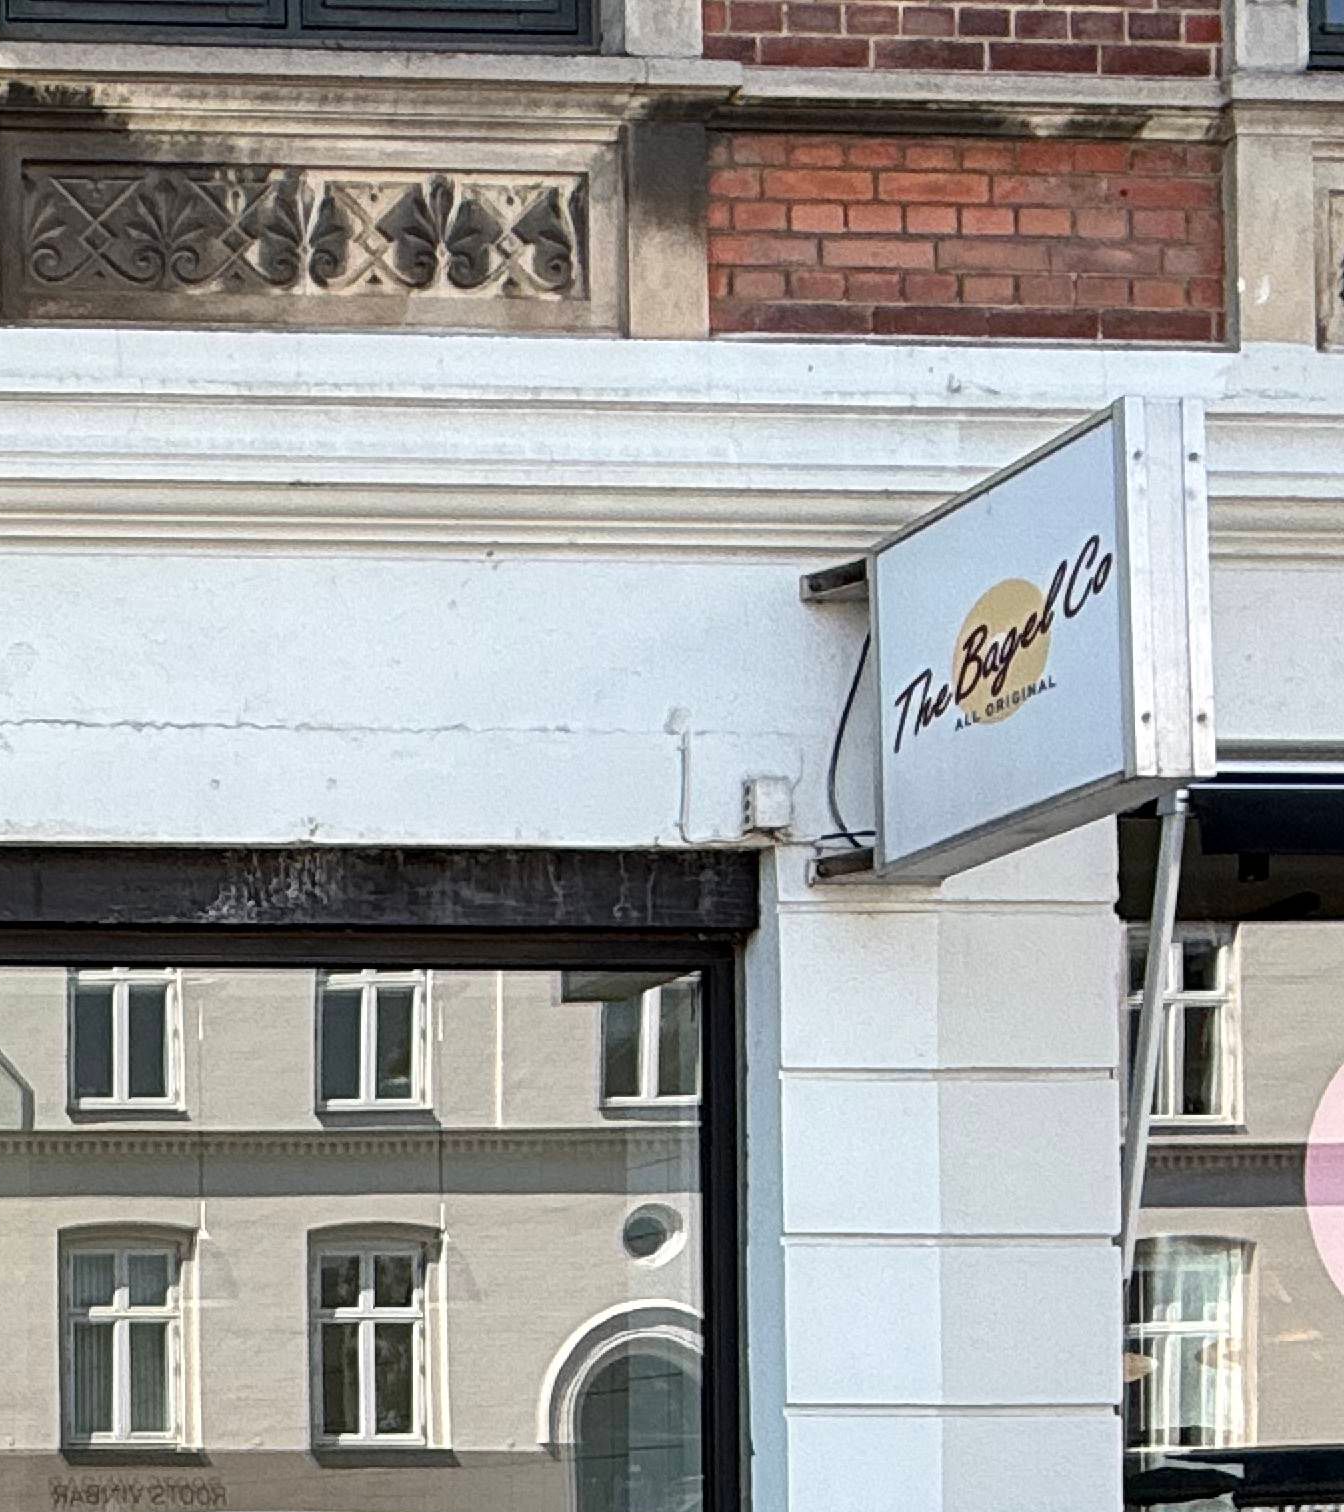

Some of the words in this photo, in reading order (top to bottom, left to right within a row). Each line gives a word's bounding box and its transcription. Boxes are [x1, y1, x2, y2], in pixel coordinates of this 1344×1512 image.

[895, 668, 952, 754] The
[954, 559, 1068, 705] Bagel
[1064, 535, 1112, 618] Co
[954, 711, 981, 731] ALL
[984, 675, 1056, 717] ORIGINAL
